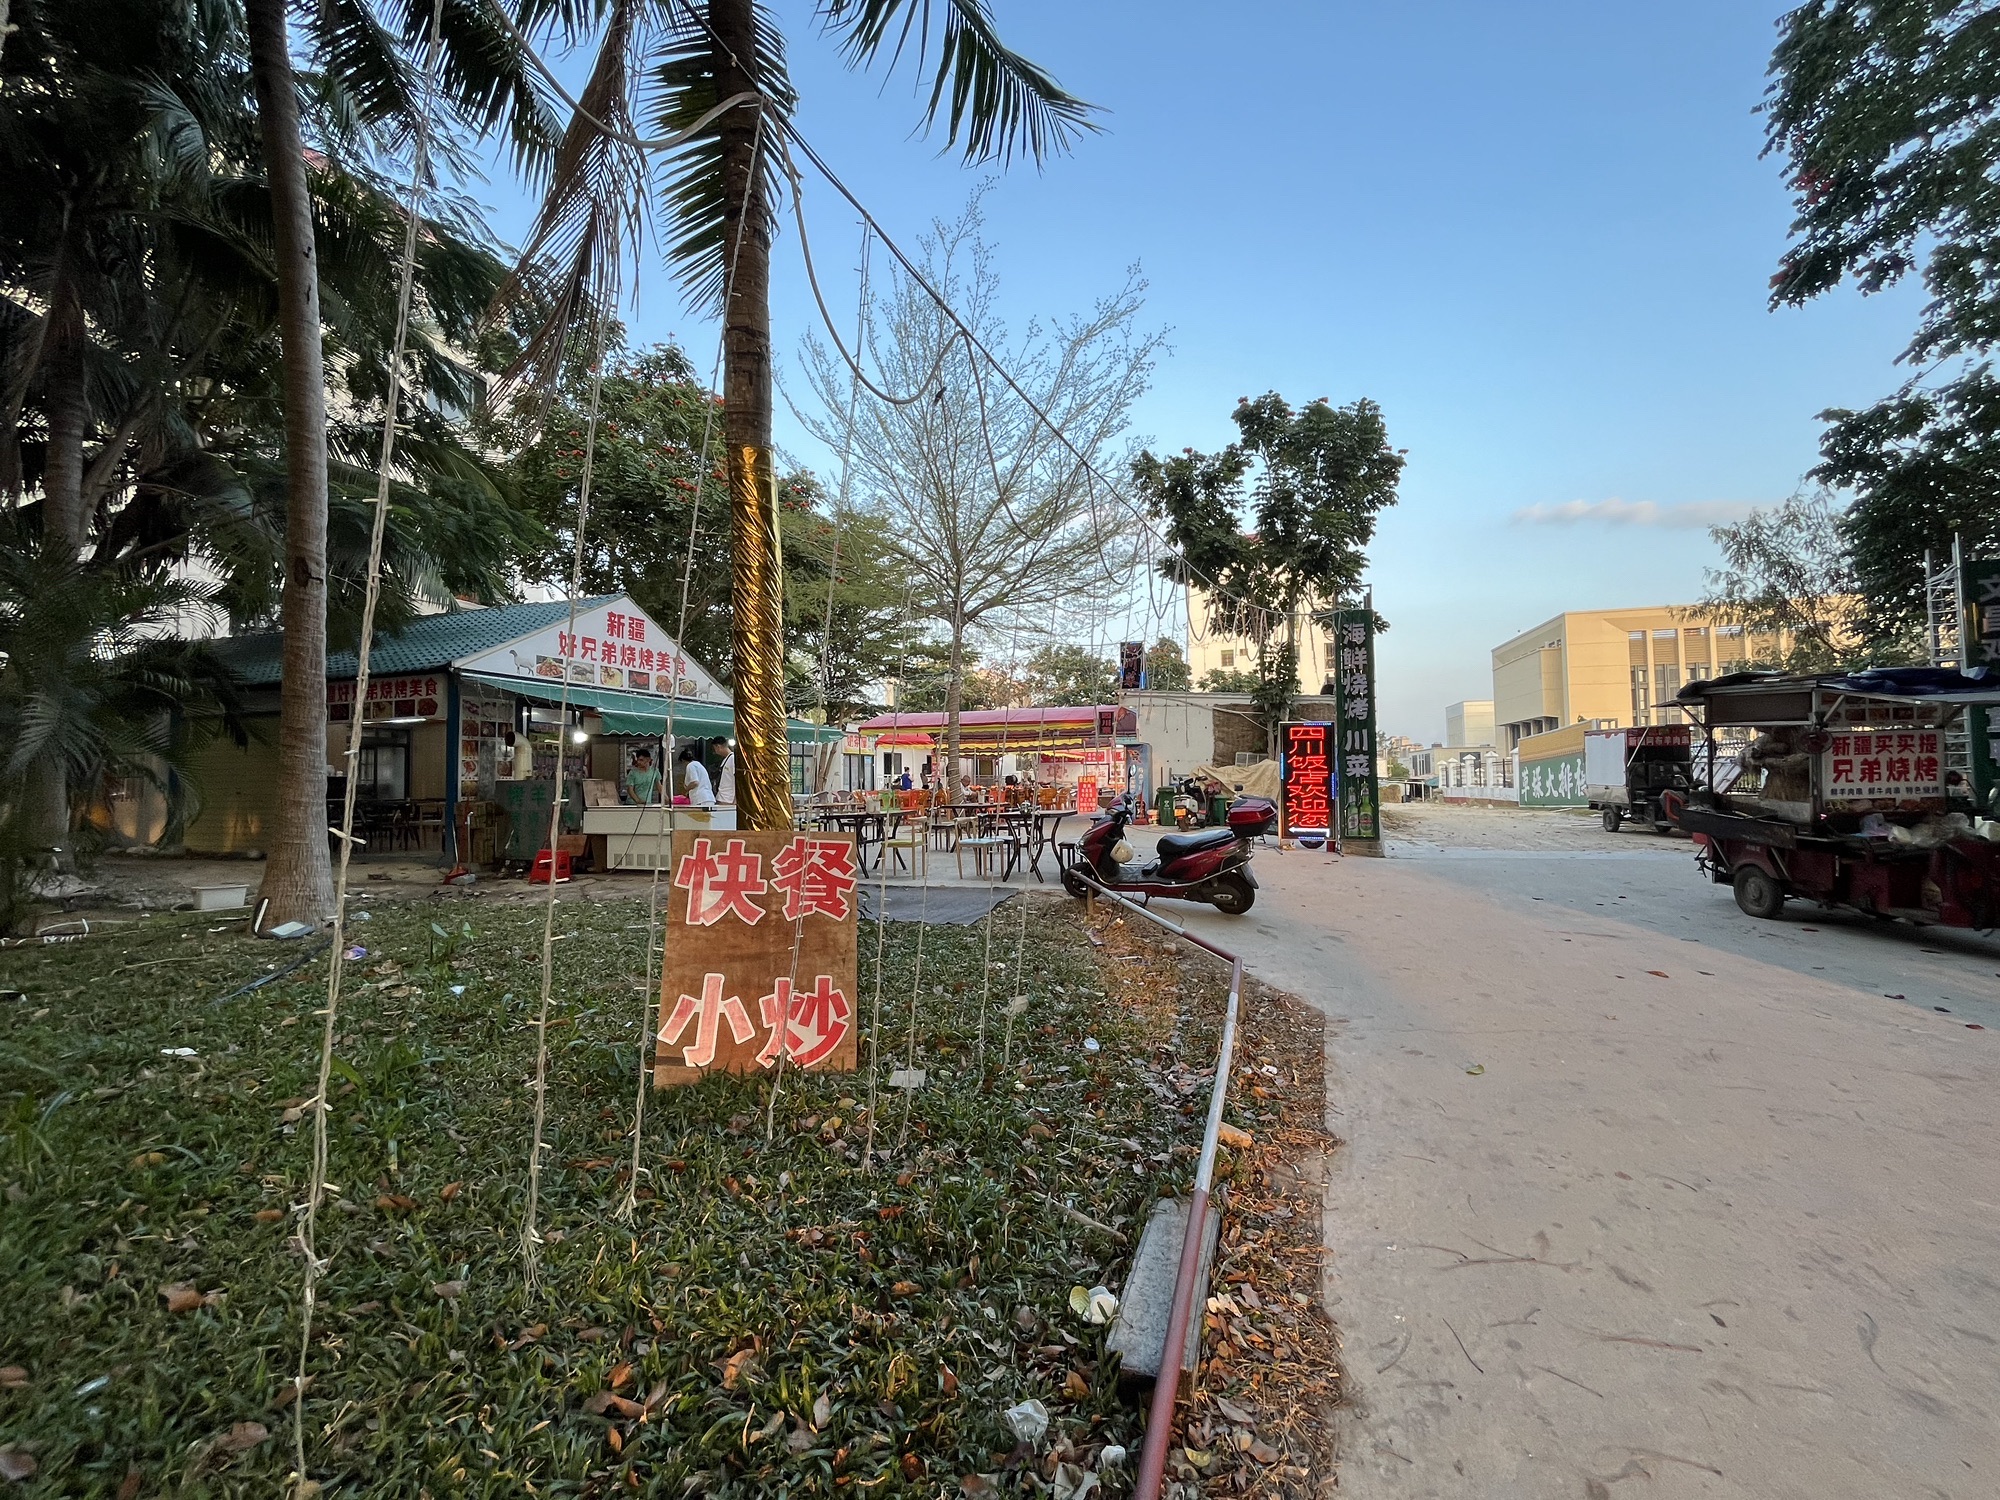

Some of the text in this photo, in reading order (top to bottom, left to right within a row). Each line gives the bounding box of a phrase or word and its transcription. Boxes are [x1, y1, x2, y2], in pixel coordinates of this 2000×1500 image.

[606, 611, 646, 643] 新疆
[558, 630, 687, 677] 好兄弟烧烤美食
[1341, 622, 1369, 721] 海鲜烧烤
[1344, 728, 1370, 778] 川菜
[1831, 733, 1938, 757] 新疆买买提
[1832, 756, 1939, 784] 兄弟烧烤
[1286, 726, 1330, 828] 四川饭店欢迎您
[674, 836, 857, 926] 快餐
[657, 972, 852, 1069] 小炒
